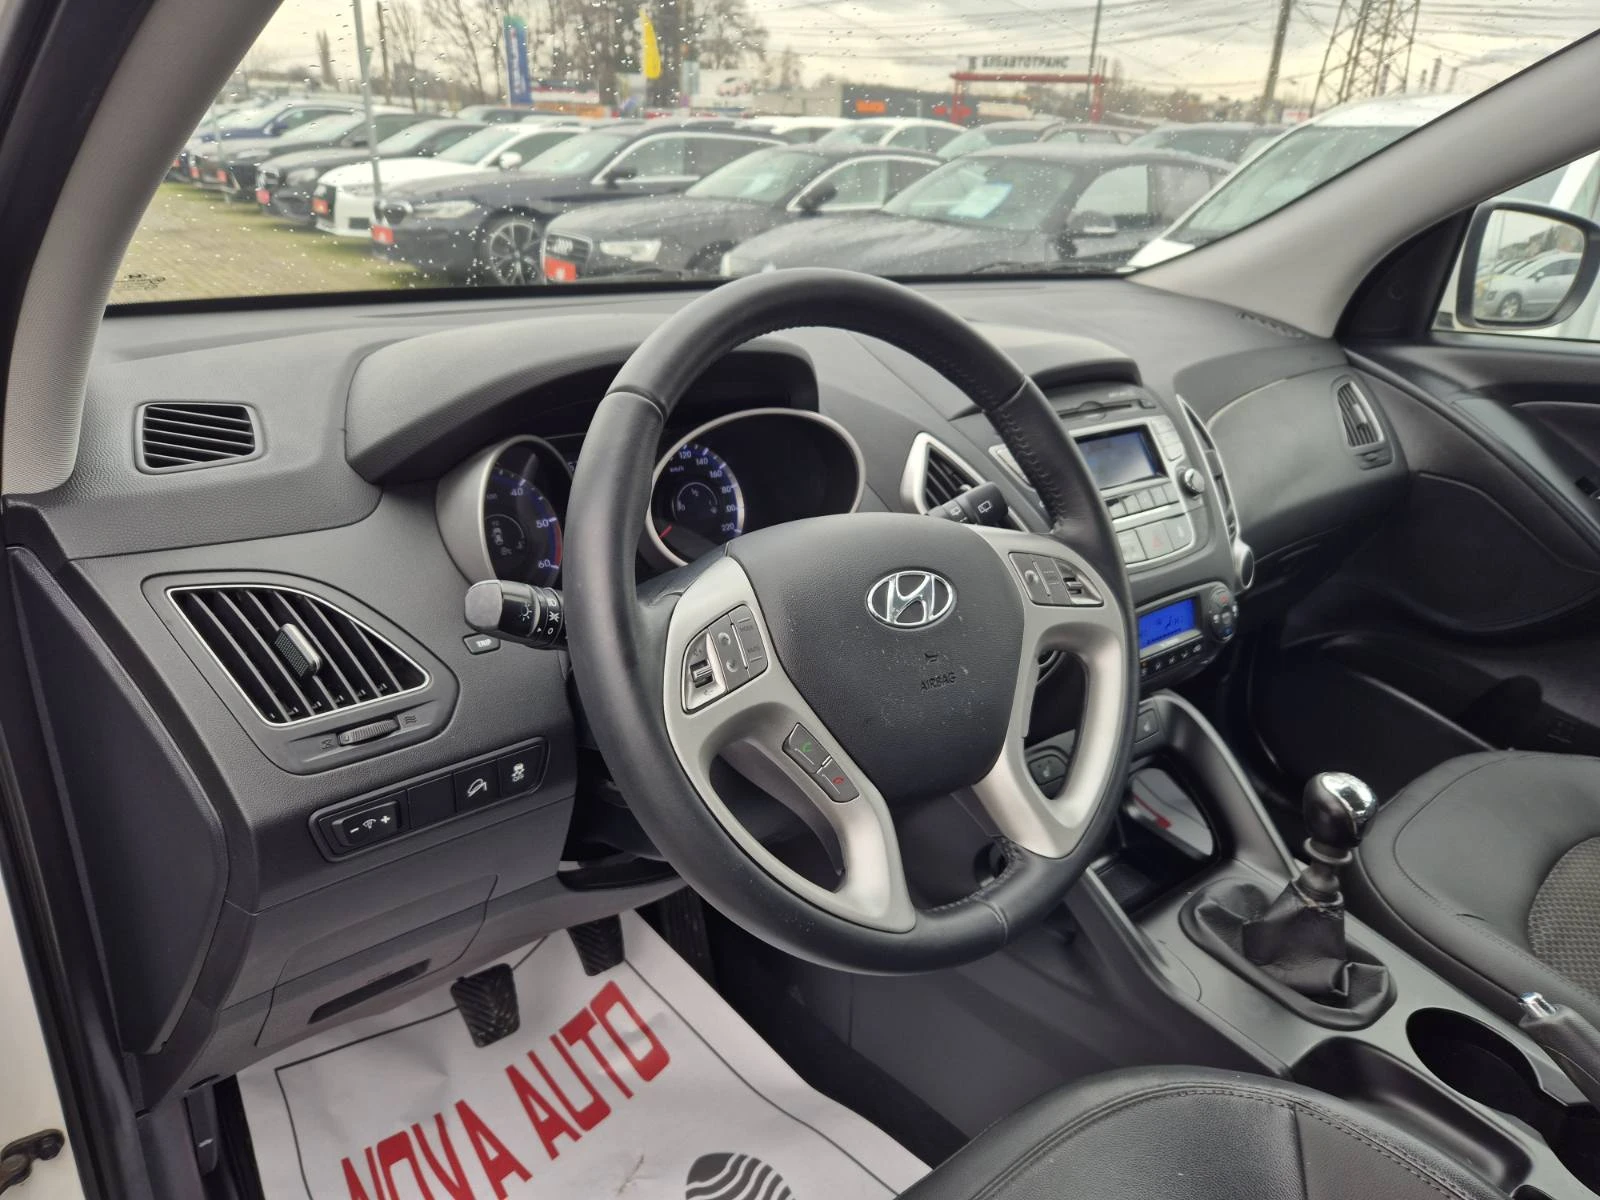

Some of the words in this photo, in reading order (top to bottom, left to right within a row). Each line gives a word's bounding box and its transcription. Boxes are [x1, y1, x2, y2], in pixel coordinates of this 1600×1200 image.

[510, 487, 524, 497] 40
[536, 519, 550, 529] 50
[538, 559, 551, 569] 60
[919, 672, 957, 691] AIRBAG
[504, 980, 671, 1161] AUTO
